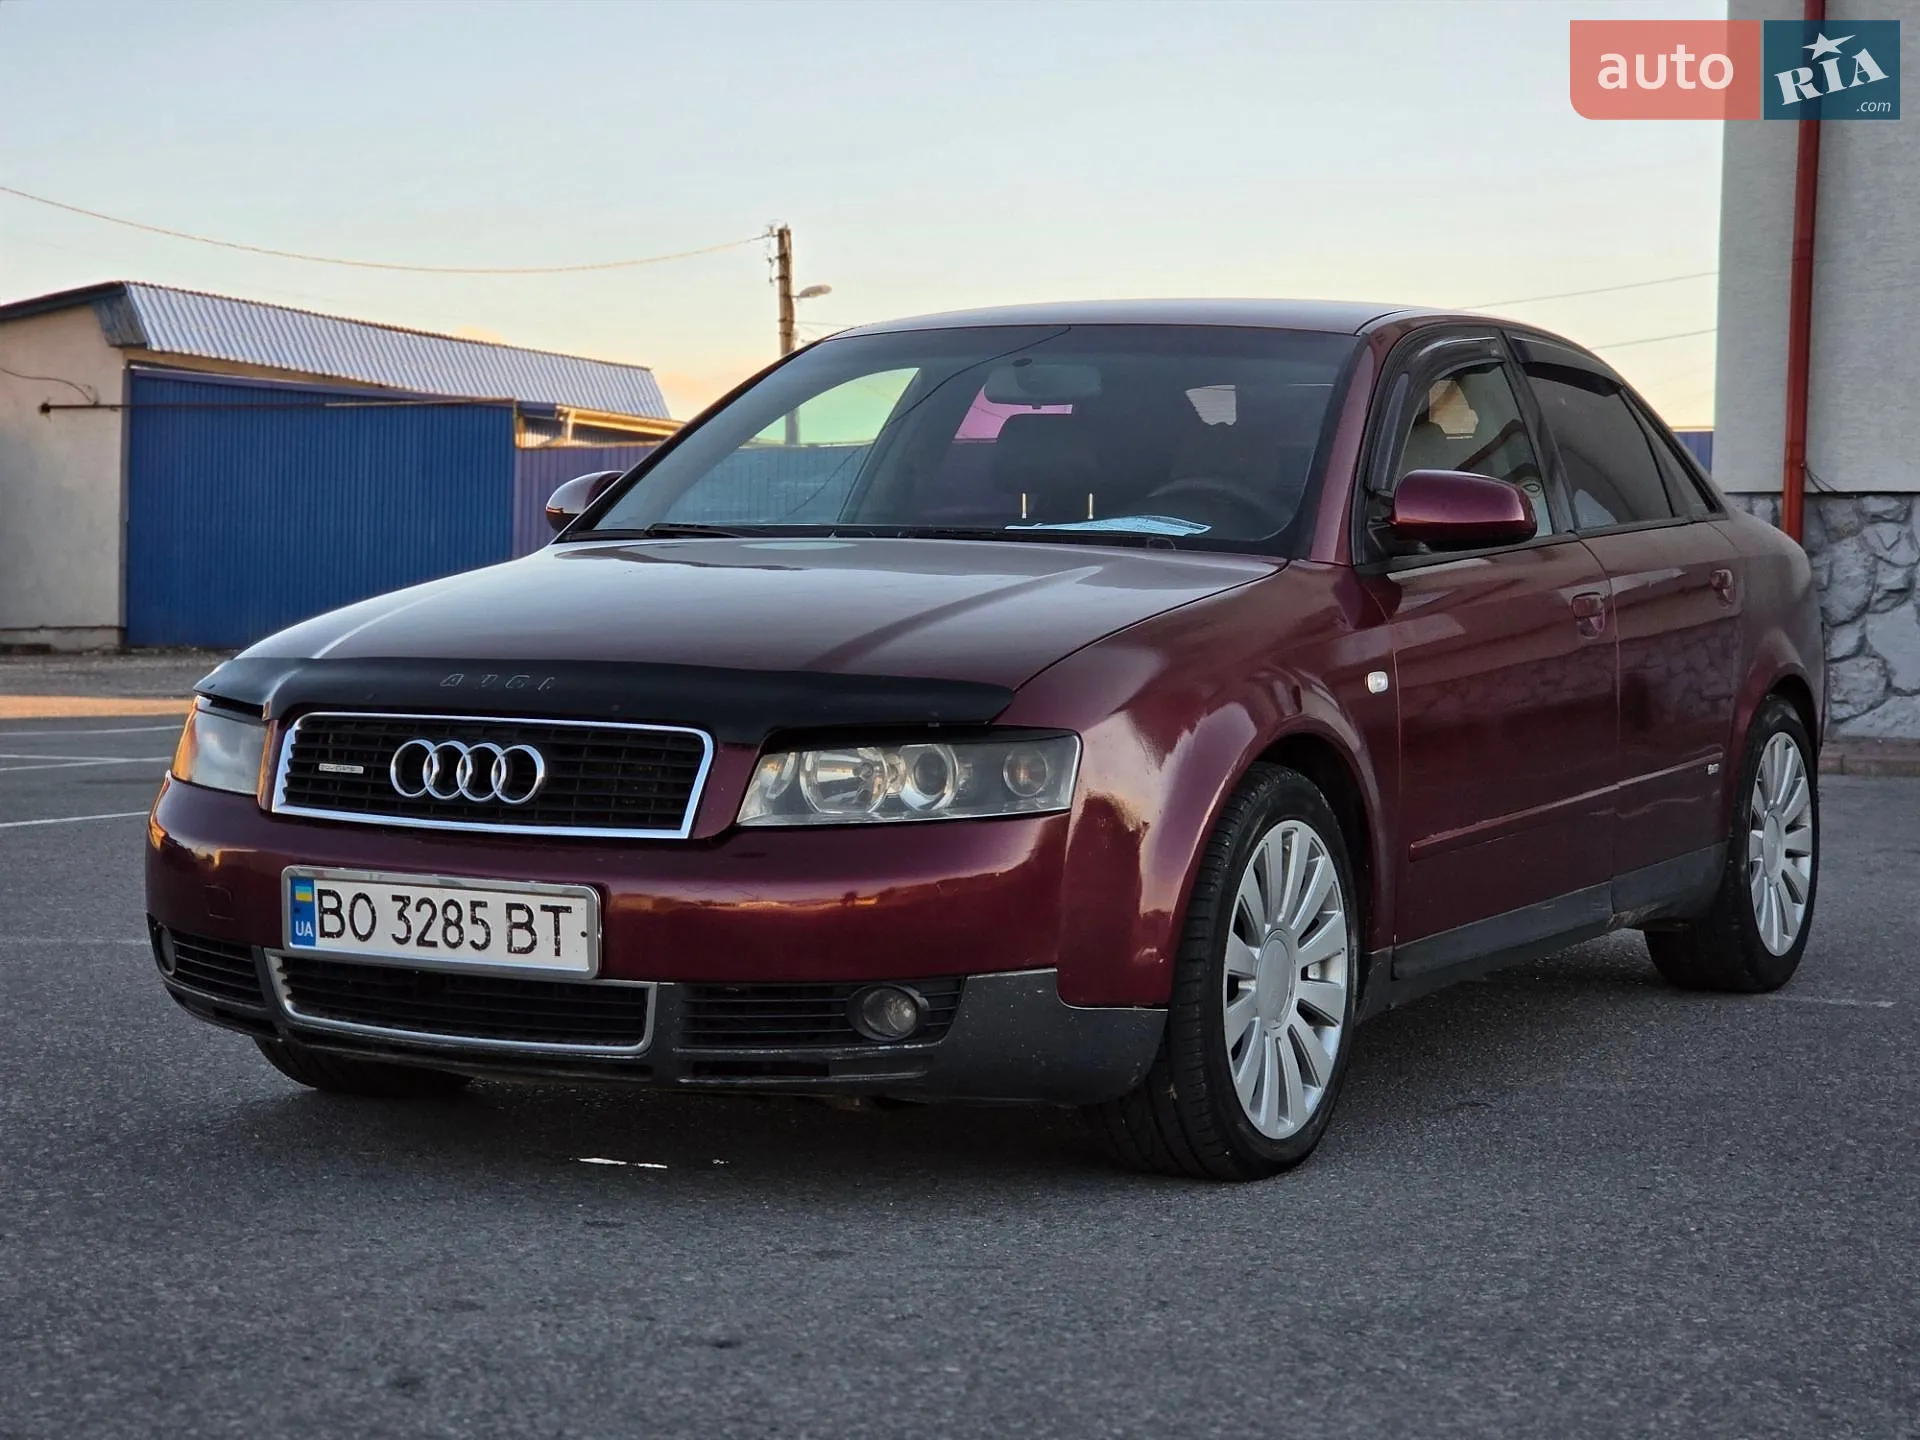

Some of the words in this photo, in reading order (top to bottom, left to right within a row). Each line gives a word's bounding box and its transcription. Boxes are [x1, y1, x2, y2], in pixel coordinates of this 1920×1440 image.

[295, 920, 314, 937] UA
[316, 888, 377, 943] BO
[391, 894, 492, 951] 3285
[505, 902, 573, 957] BT
